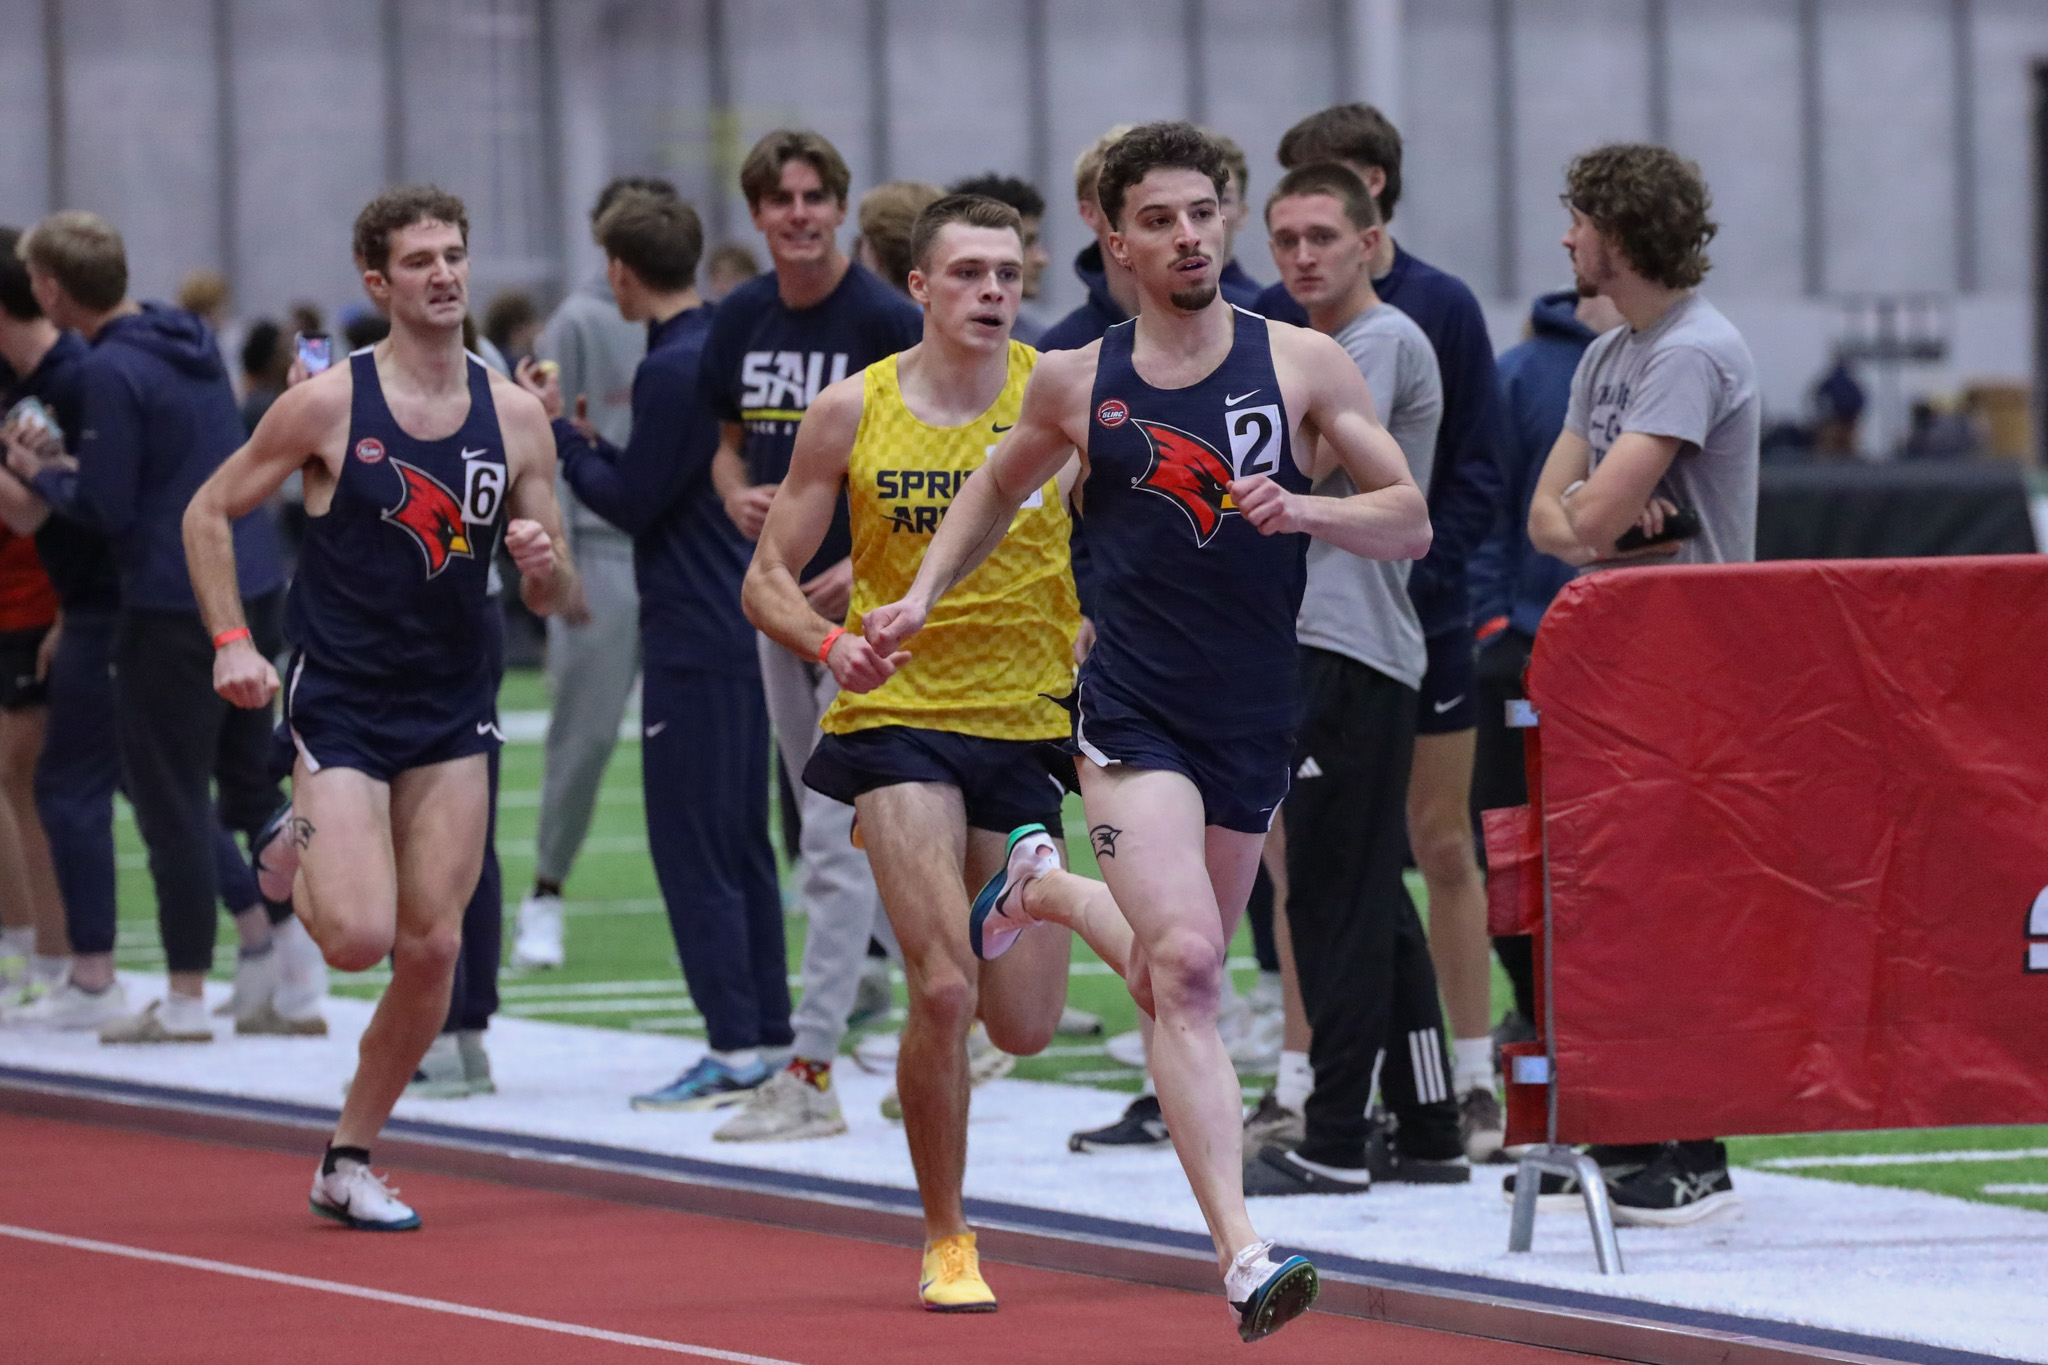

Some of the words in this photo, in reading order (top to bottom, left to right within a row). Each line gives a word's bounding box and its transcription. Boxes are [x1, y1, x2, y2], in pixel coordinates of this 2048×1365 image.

[1234, 412, 1273, 478] 2
[470, 467, 498, 519] 6
[877, 470, 974, 499] SPRI
[883, 506, 949, 534] AR
